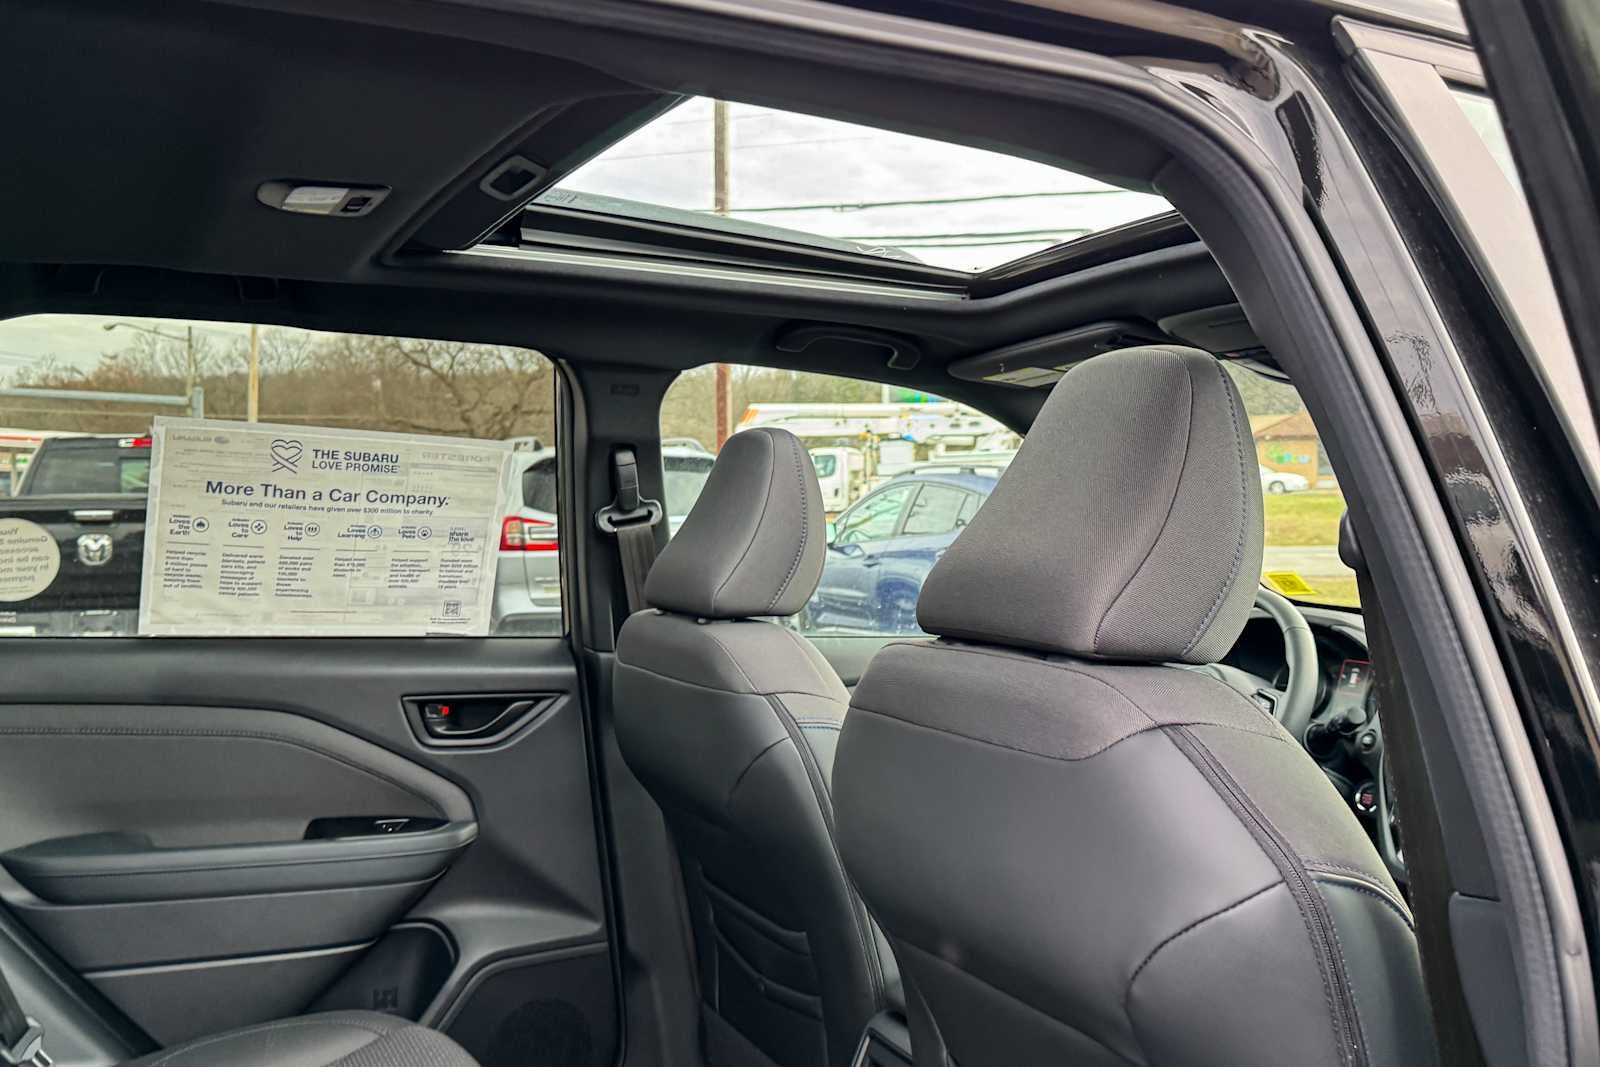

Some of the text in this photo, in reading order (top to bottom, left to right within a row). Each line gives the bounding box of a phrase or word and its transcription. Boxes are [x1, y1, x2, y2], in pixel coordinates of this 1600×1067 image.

[312, 449, 399, 464] THE SUBARU
[312, 460, 400, 474] LOVE PROMISE
[206, 480, 450, 508] More Than a Car Company.
[222, 499, 248, 507] Subaru
[278, 502, 306, 511] retailers
[326, 506, 346, 514] given
[412, 508, 433, 517] charity
